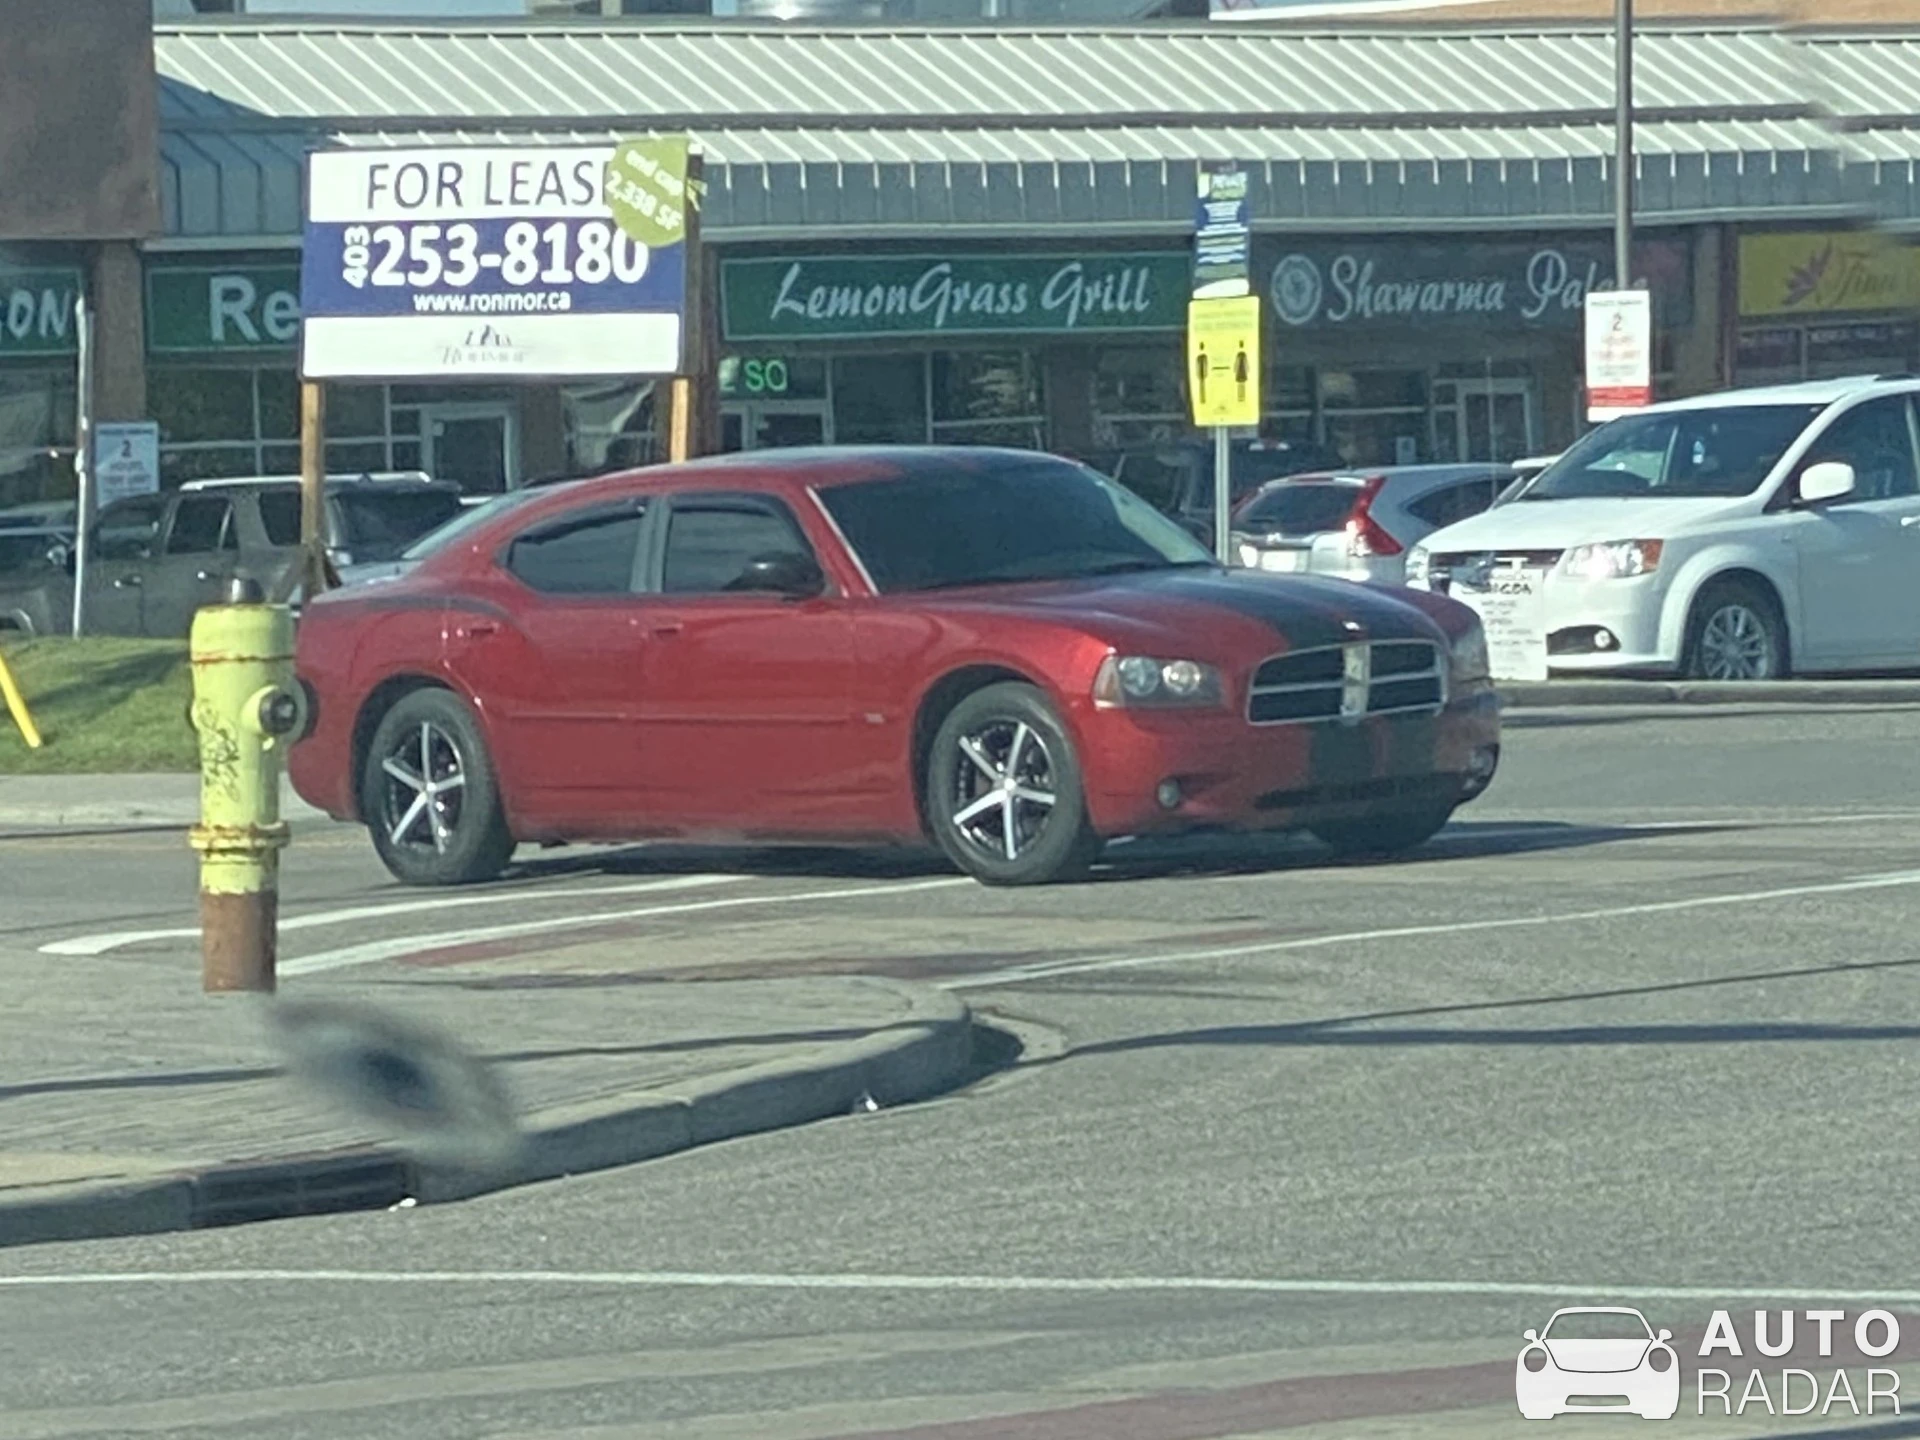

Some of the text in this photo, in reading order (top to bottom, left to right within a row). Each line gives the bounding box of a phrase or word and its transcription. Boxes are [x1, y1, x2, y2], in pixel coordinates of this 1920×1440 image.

[366, 162, 464, 210] FOR
[625, 150, 659, 177] end
[605, 169, 684, 231] 2,338 SF
[342, 225, 371, 289] 403
[371, 221, 650, 288] 253-8180
[413, 291, 572, 312] www.ronmor.ca
[771, 262, 1151, 327] LemonGrass Grill
[1327, 254, 1503, 321] Shawarma
[0, 288, 71, 339] ON
[1611, 311, 1623, 332] 2
[120, 439, 132, 458] 2
